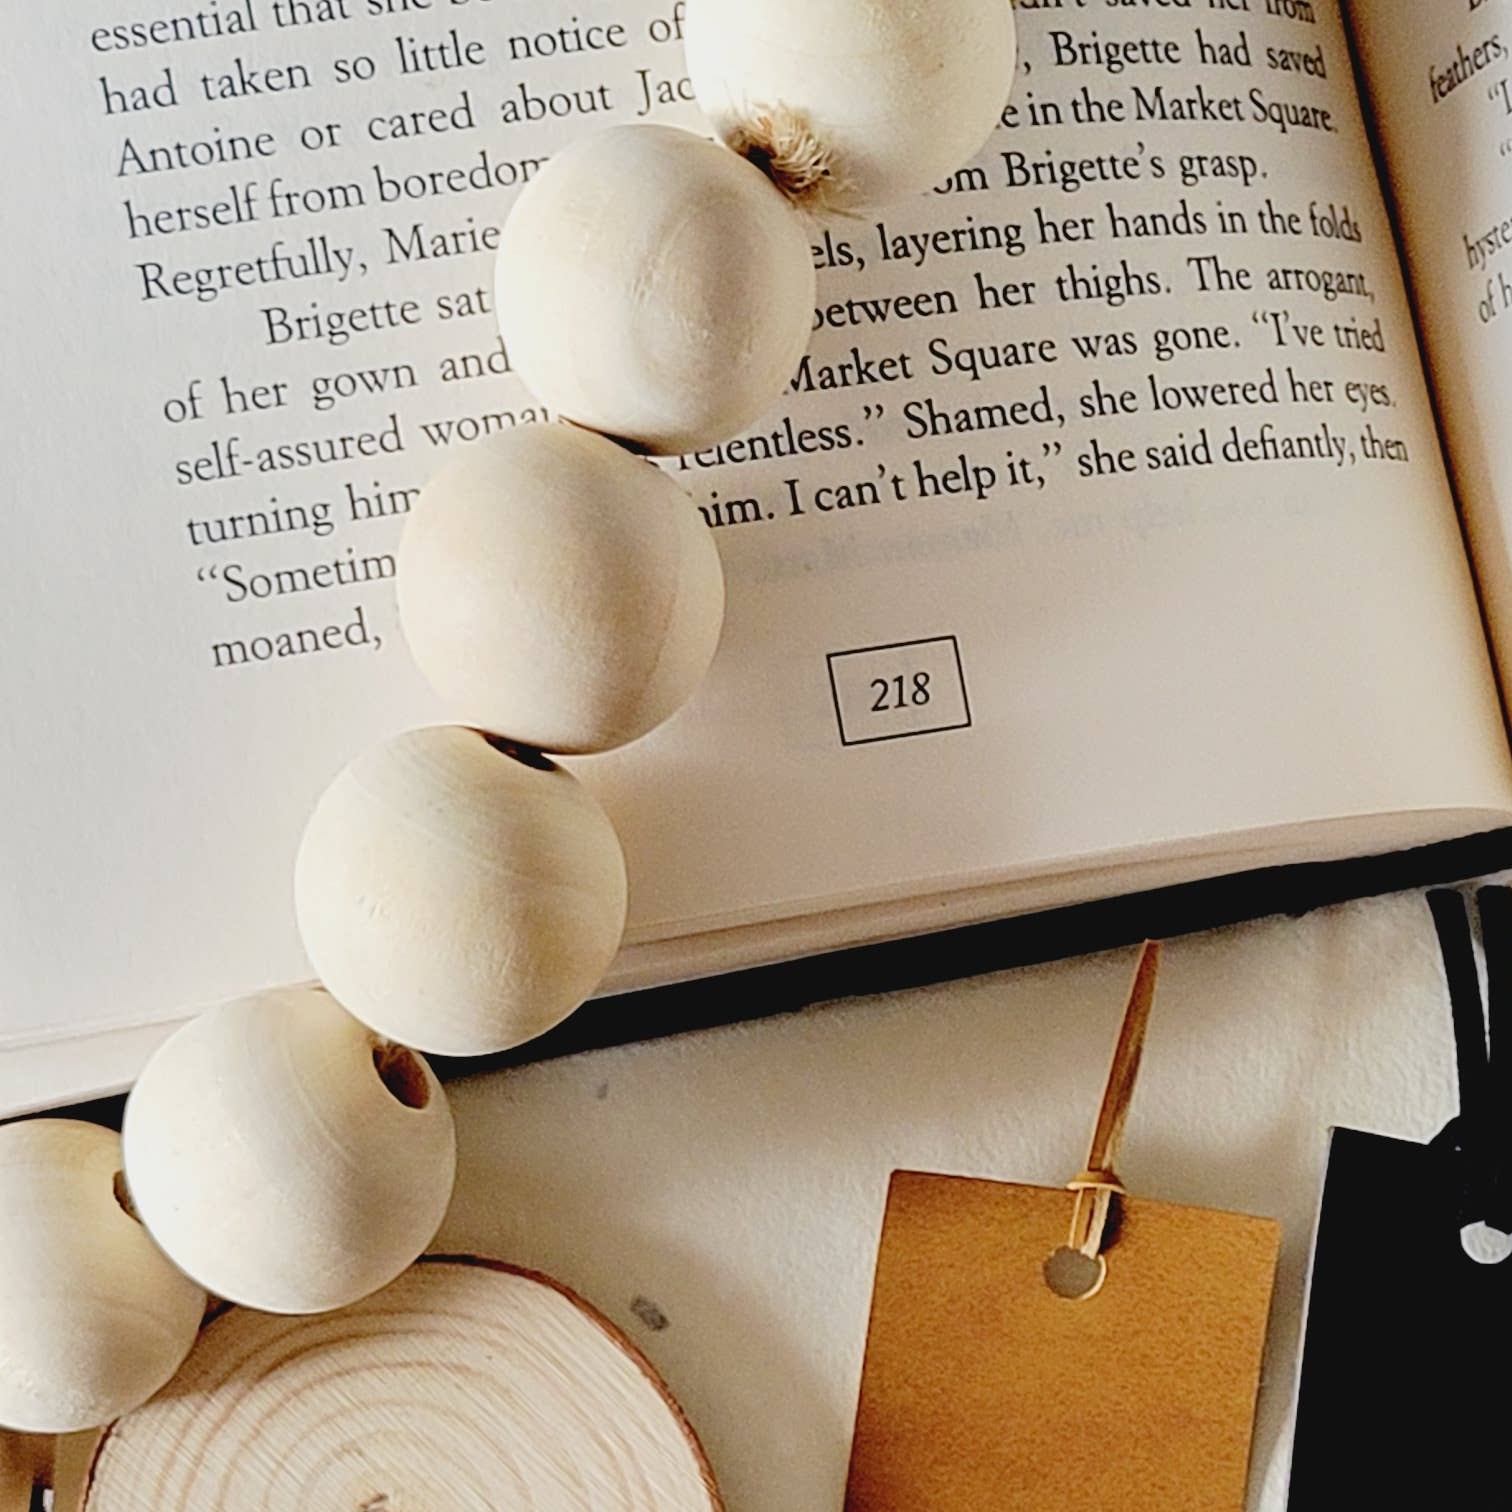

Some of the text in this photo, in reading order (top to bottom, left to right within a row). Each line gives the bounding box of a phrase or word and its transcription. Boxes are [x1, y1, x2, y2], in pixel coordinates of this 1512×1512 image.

[90, 0, 353, 53] essential that
[98, 66, 180, 116] had
[200, 56, 313, 102] taken
[333, 55, 376, 84] so
[394, 28, 487, 75] little
[507, 15, 627, 61] notice
[647, 0, 686, 43] of
[1428, 33, 1509, 105] feathers,
[116, 126, 277, 178] Antoine
[299, 122, 343, 151] or
[367, 89, 477, 142] cared
[500, 81, 614, 124] about
[1046, 29, 1182, 75] Brigette
[1193, 26, 1253, 68] had
[1265, 44, 1328, 81] saved
[122, 181, 260, 240] herself
[267, 177, 367, 218] from
[1025, 90, 1065, 127] in
[1069, 85, 1127, 125] the
[1129, 83, 1246, 123] Market
[133, 234, 368, 303] Regretfully,
[381, 216, 502, 265] Marie
[999, 140, 1166, 194] Brigette’s
[1178, 154, 1268, 188] grasp.
[259, 300, 422, 347] Brigette
[435, 287, 492, 321] sat
[875, 215, 1027, 268] layering
[1032, 205, 1096, 245] her
[1104, 197, 1208, 239] hands
[1215, 199, 1249, 235] in
[1256, 197, 1304, 236] the
[1308, 200, 1363, 244] folds
[163, 379, 204, 424] of
[219, 375, 289, 415] her
[311, 364, 419, 412] gown
[439, 334, 513, 383] and
[972, 271, 1037, 310] her
[1054, 258, 1172, 308] thighs.
[1185, 253, 1253, 292] The
[1265, 267, 1376, 305] arrogant,
[1477, 278, 1497, 324] of
[175, 412, 406, 486] self-assured
[927, 336, 1059, 382] Square
[1069, 330, 1139, 360] was
[1152, 325, 1241, 363] gone.
[1332, 316, 1386, 354] tried
[186, 496, 335, 547] turning
[902, 384, 1066, 440] Shamed,
[1078, 378, 1139, 419] she
[1147, 366, 1280, 412] lowered
[1285, 365, 1335, 403] her
[782, 477, 807, 517] I
[813, 462, 909, 513] can’t
[911, 453, 997, 501] help
[1005, 440, 1062, 491] it,”
[1077, 437, 1138, 478] she
[1144, 427, 1215, 471] said
[1221, 421, 1357, 468] defiantly,
[1359, 423, 1410, 463] then
[211, 605, 382, 668] moaned,
[869, 671, 931, 713] 218
